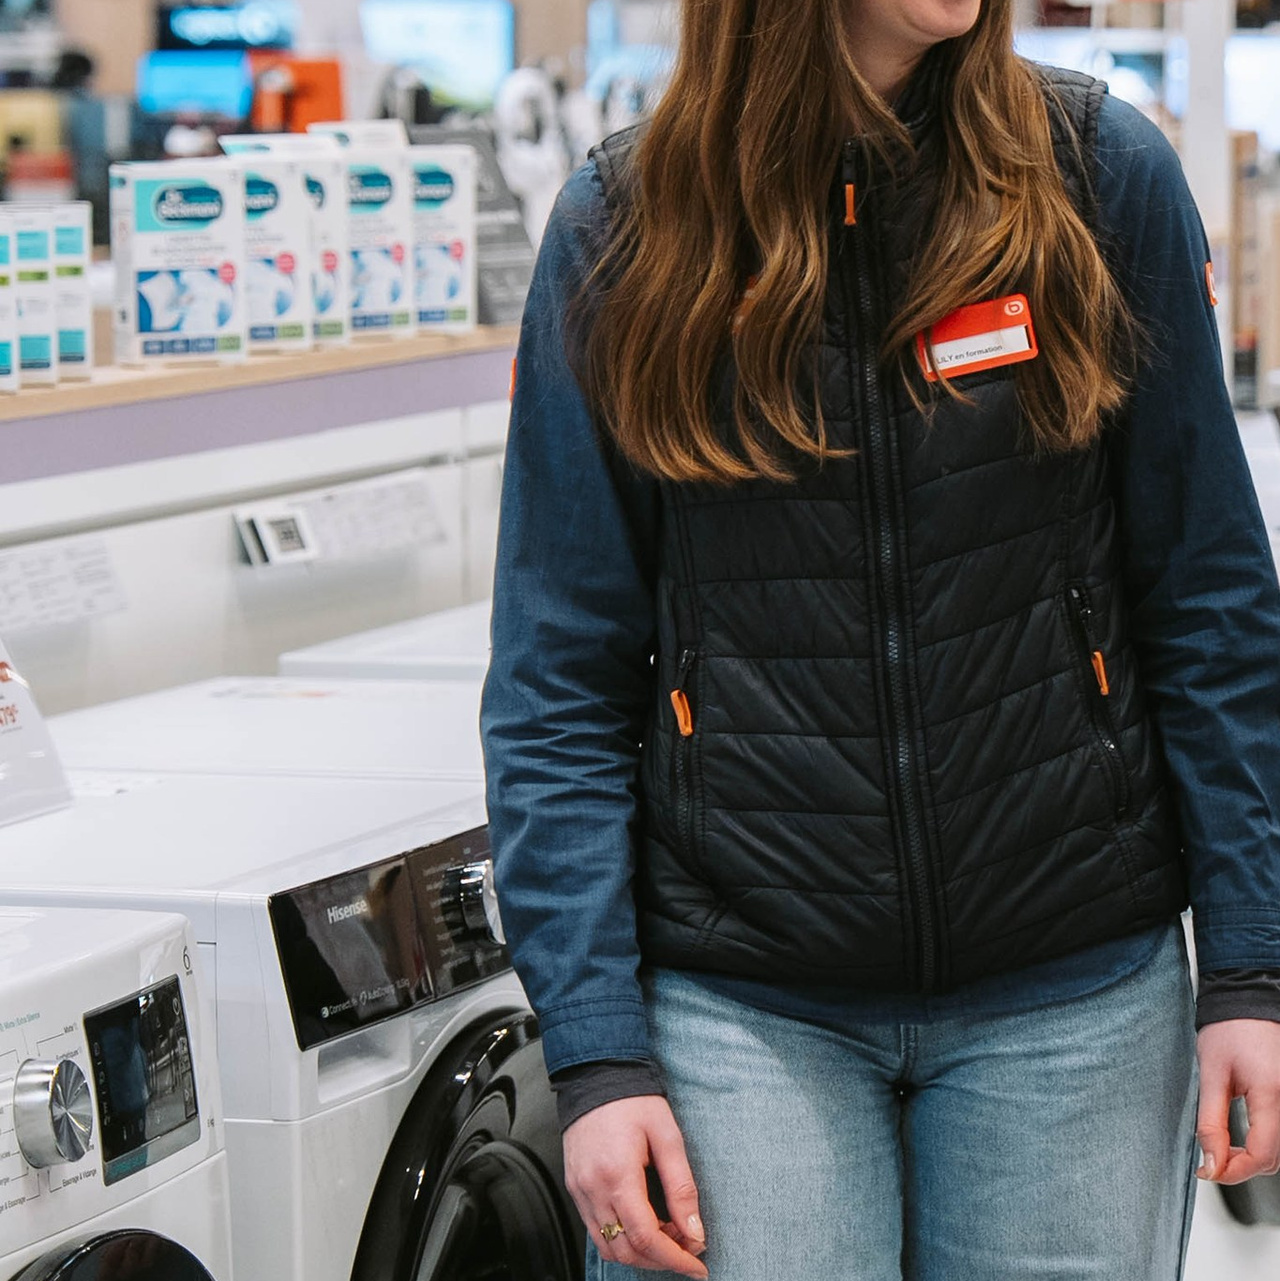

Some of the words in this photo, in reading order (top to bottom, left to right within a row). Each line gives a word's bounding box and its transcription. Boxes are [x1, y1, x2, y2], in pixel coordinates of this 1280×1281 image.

[955, 353, 965, 361] en
[966, 344, 1003, 358] formation
[327, 900, 368, 924] Hisense
[183, 945, 191, 970] 6
